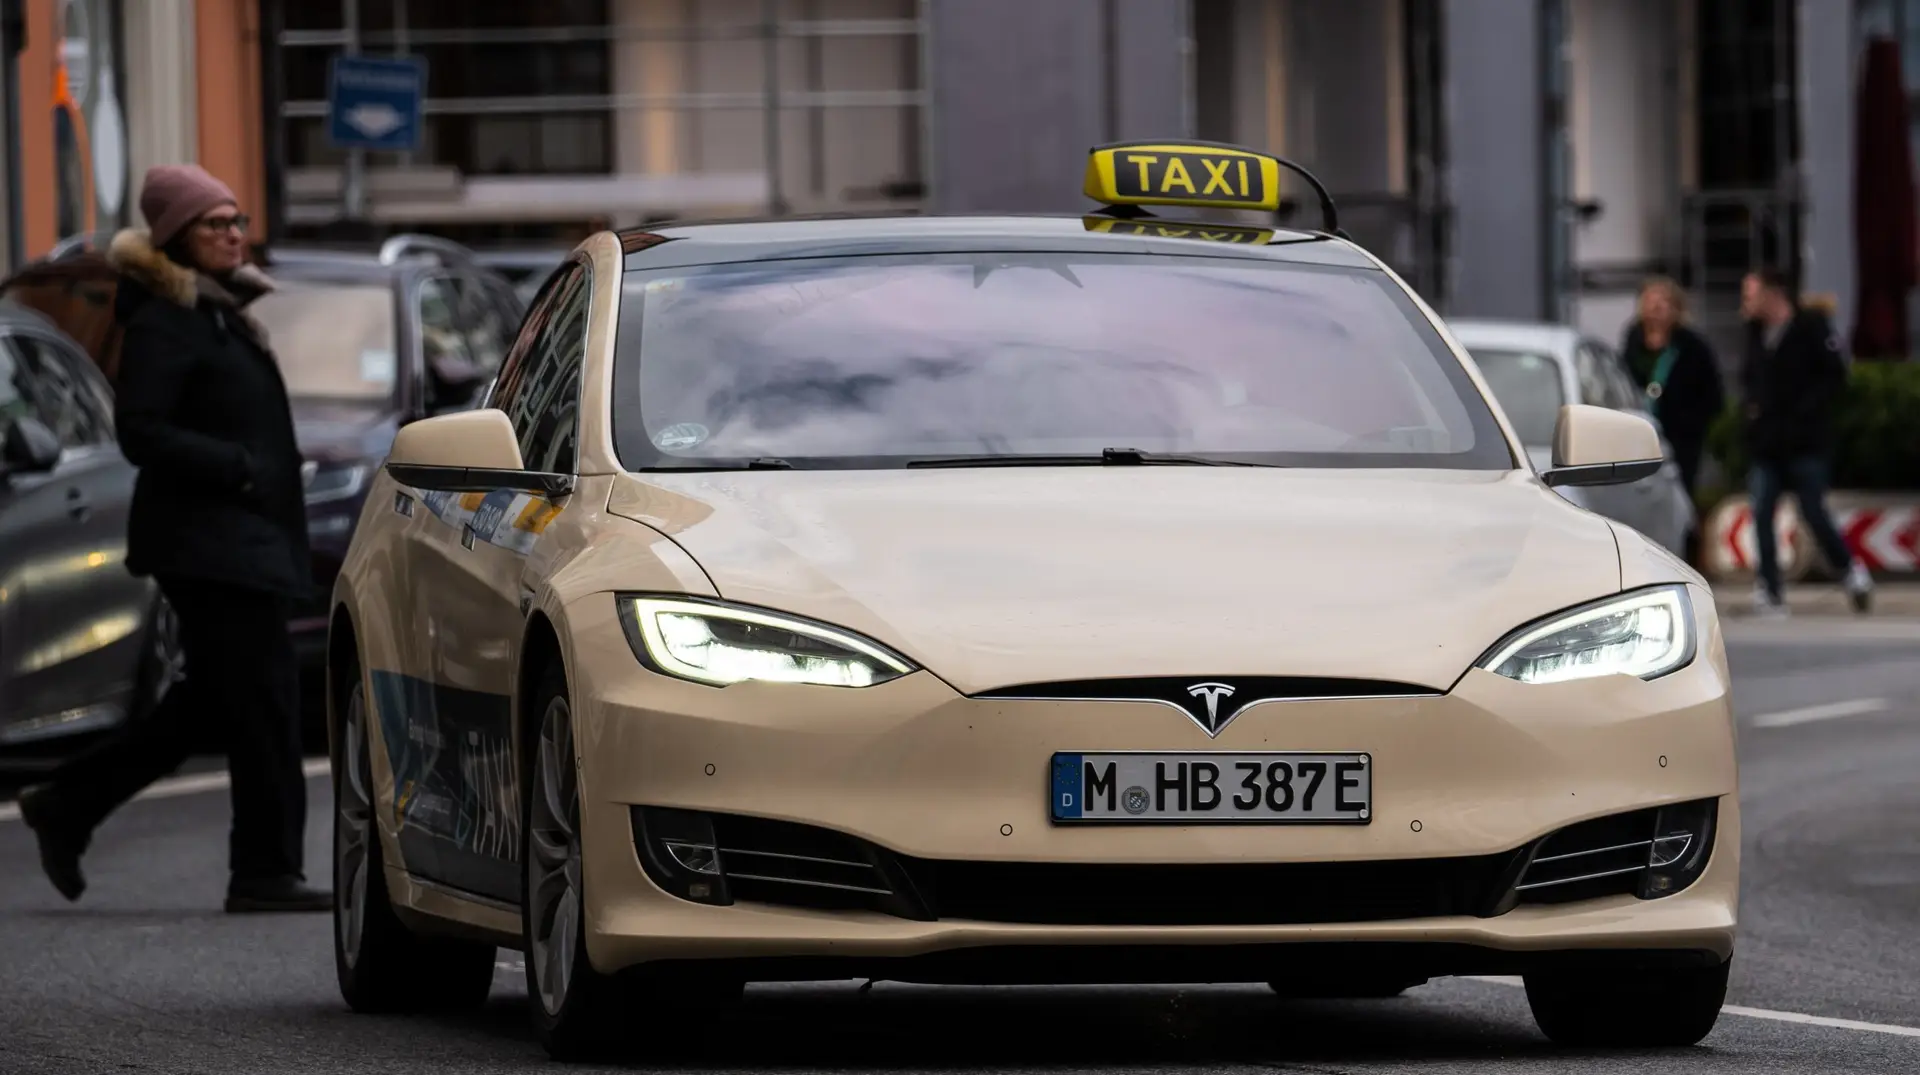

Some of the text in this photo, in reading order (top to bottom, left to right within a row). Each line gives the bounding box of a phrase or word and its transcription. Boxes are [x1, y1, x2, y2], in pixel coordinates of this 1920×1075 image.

[1127, 154, 1250, 197] TAXI
[1062, 793, 1073, 807] D
[1084, 761, 1117, 811] M
[1155, 761, 1222, 811] HB
